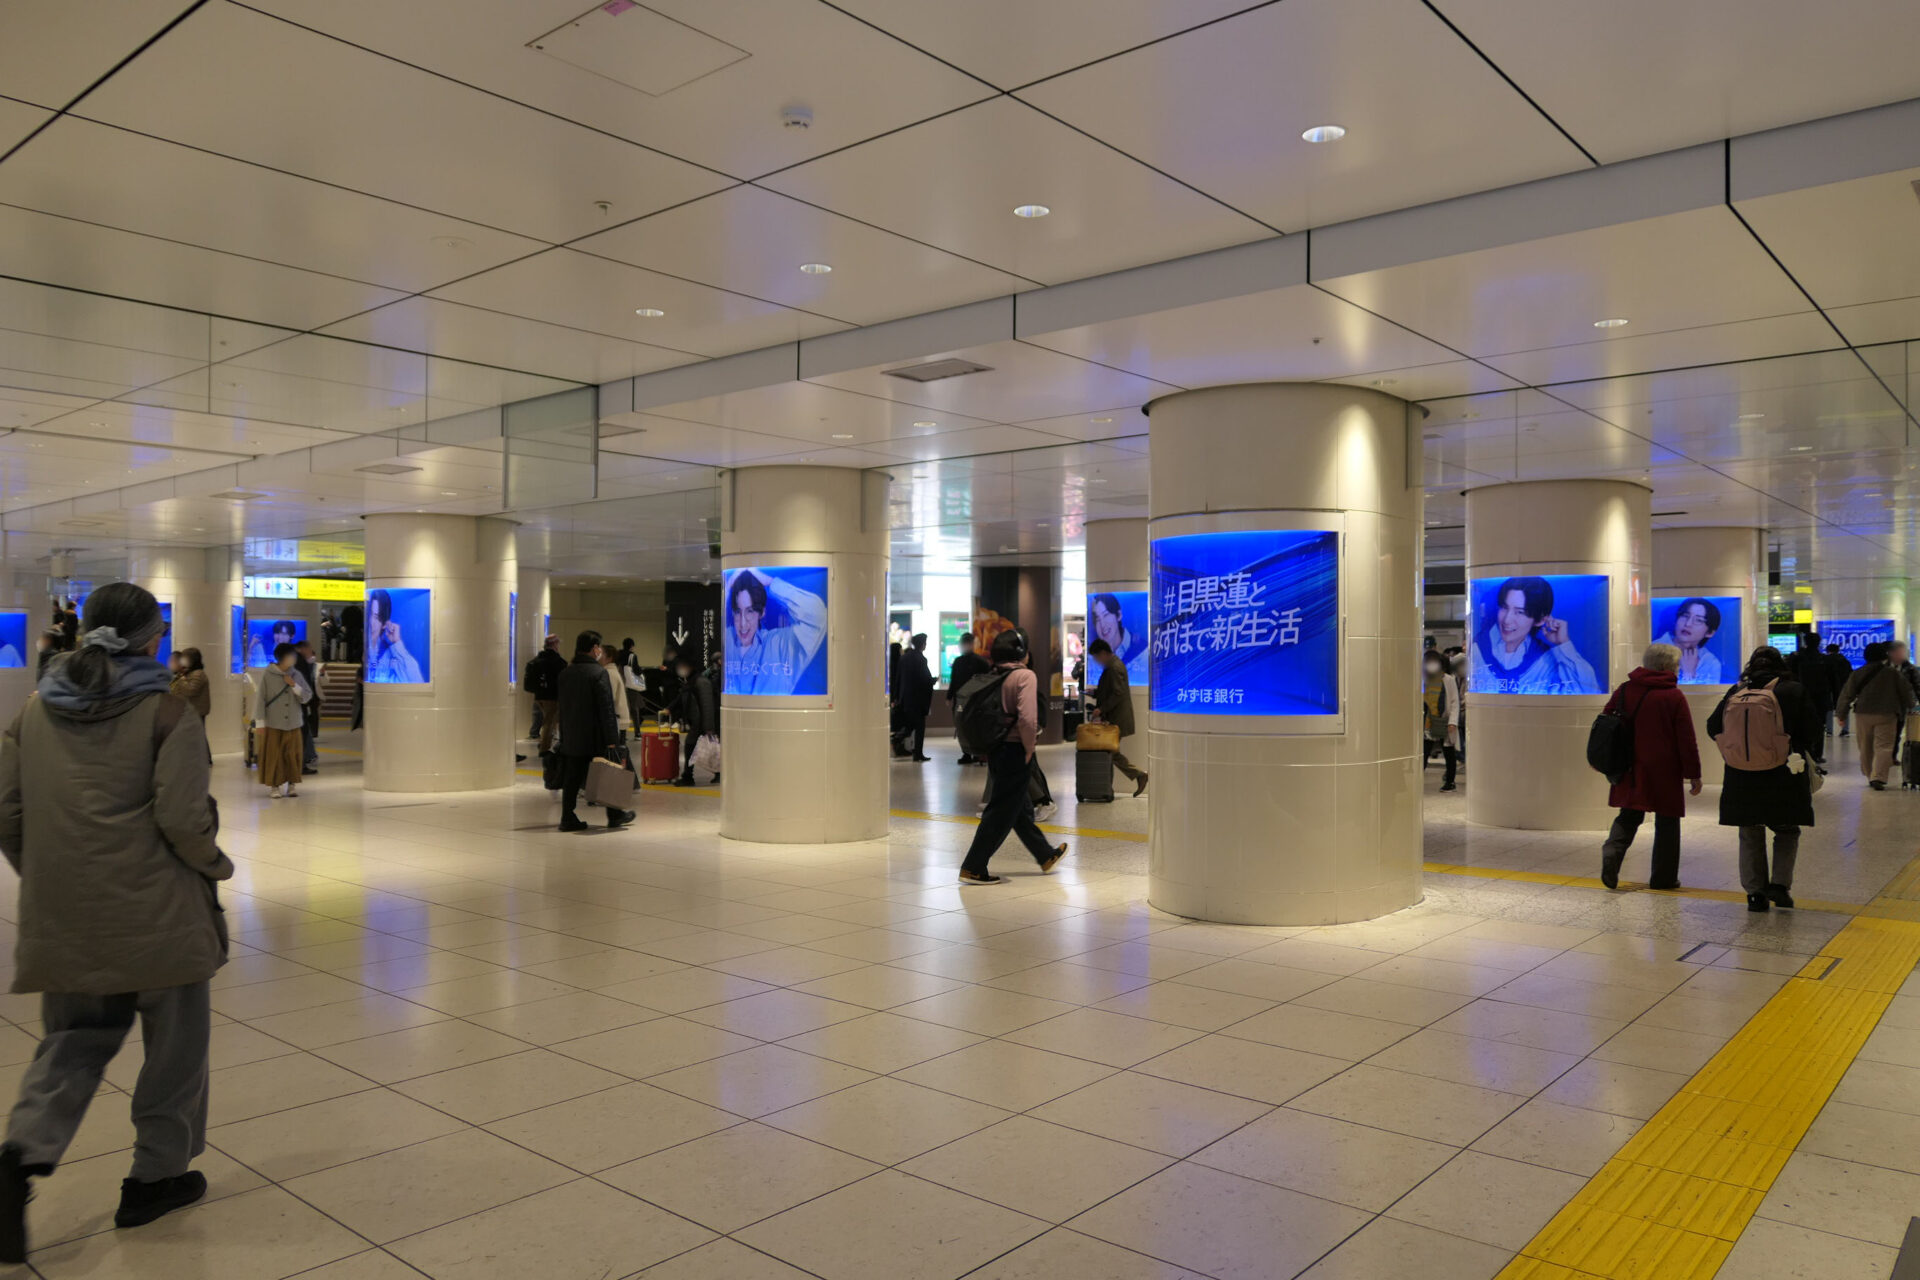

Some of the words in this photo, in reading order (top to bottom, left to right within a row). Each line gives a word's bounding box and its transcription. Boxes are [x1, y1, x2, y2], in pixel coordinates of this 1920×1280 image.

[1163, 571, 1267, 617] #目黒蓮と
[1152, 607, 1303, 659] みずほで新生活
[1176, 687, 1245, 705] みずほ銀行
